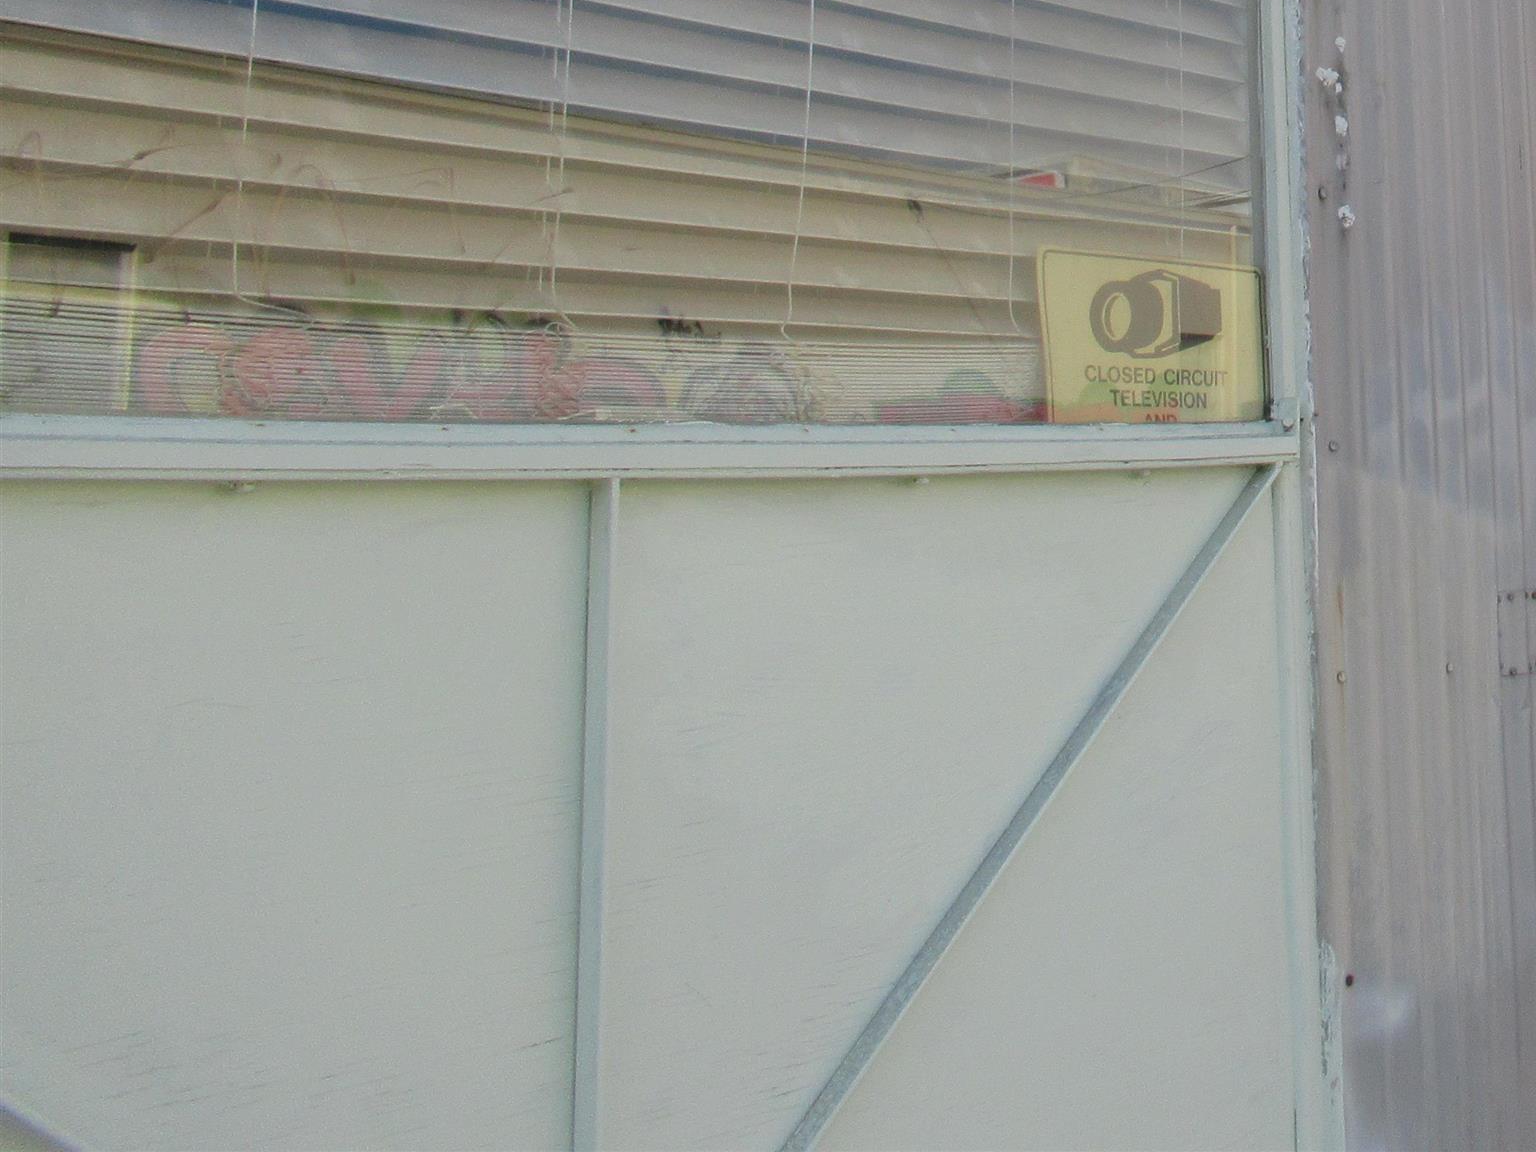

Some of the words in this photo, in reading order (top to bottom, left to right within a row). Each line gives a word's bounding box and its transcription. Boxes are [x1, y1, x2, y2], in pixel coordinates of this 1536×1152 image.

[1084, 364, 1157, 385] CLOSED
[1163, 368, 1229, 387] CIRCUIT
[1109, 389, 1208, 409] TELEVISION
